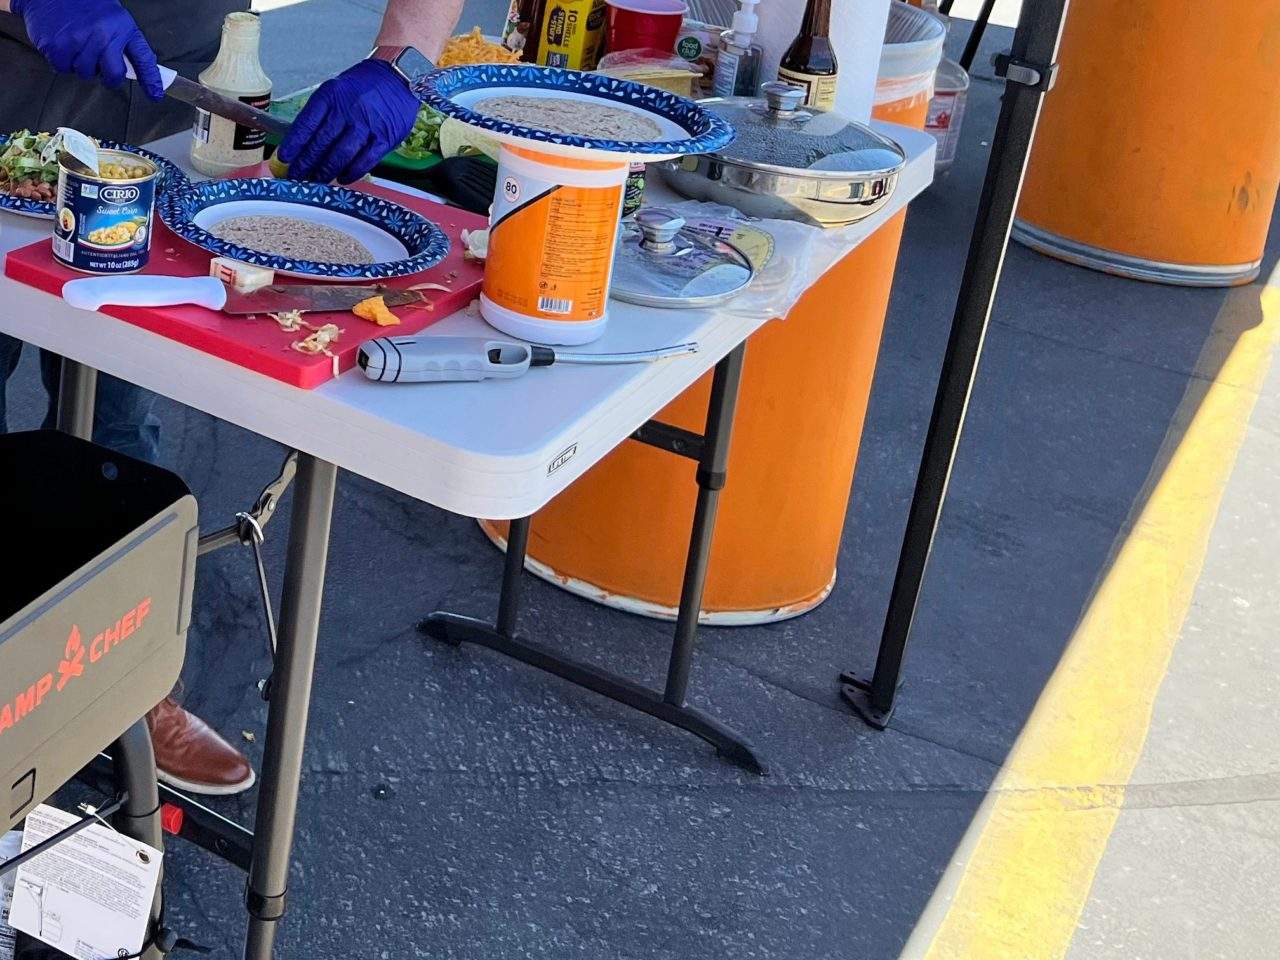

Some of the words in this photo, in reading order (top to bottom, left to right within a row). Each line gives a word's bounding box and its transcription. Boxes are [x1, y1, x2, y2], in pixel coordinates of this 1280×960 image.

[556, 11, 565, 35] STAND
[567, 10, 578, 23] 10
[682, 40, 698, 49] food
[504, 181, 517, 194] 80
[96, 205, 120, 215] Sweet
[121, 207, 138, 215] Corn
[107, 261, 116, 269] 10
[89, 596, 152, 664] CHEF
